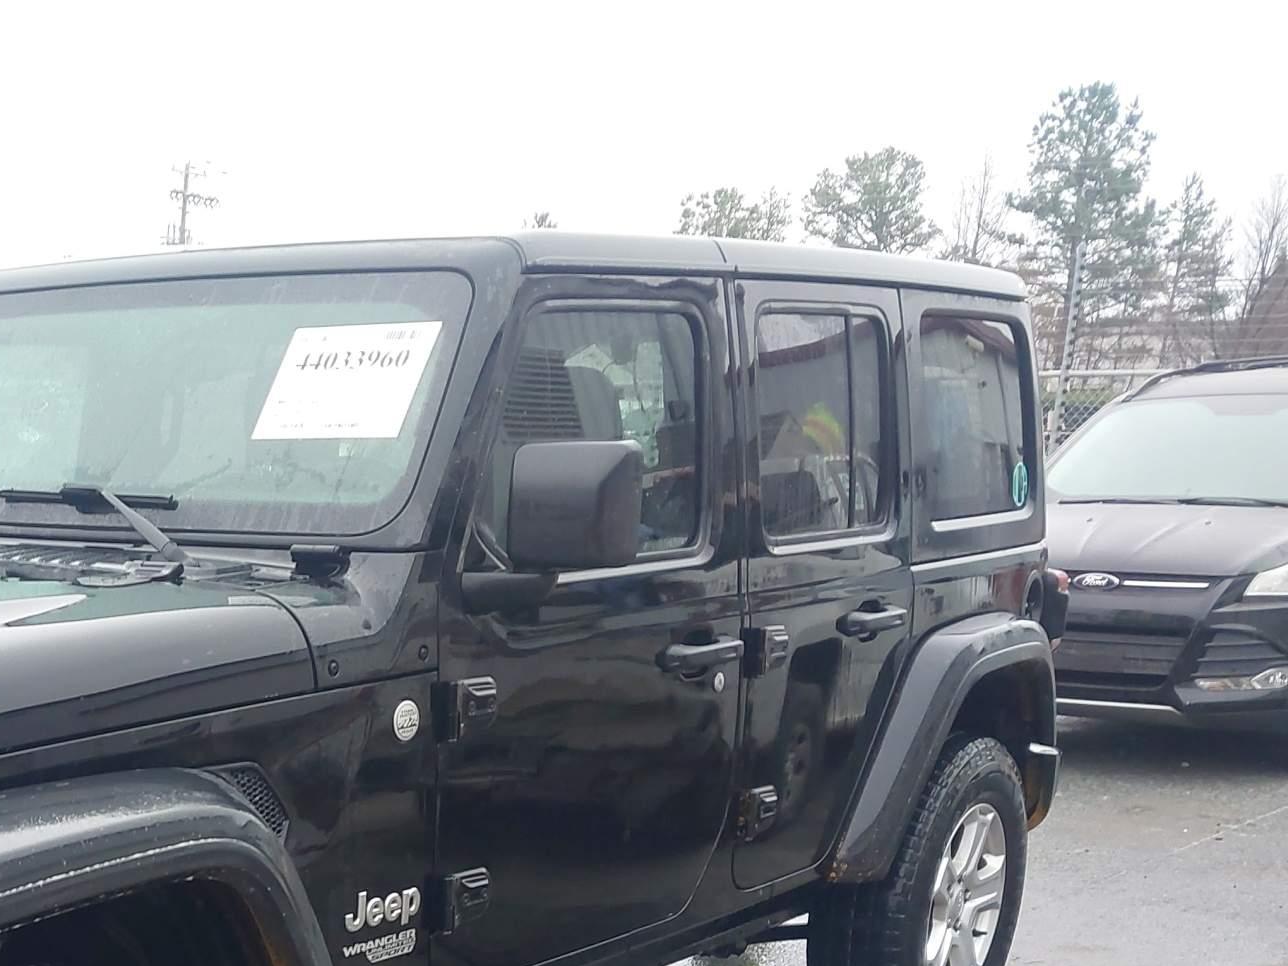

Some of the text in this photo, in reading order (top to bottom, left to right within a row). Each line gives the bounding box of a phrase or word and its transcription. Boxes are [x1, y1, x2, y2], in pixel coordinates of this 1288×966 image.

[295, 349, 411, 371] 44033960
[344, 886, 421, 933] Jeep
[342, 928, 416, 958] WRANGLER
